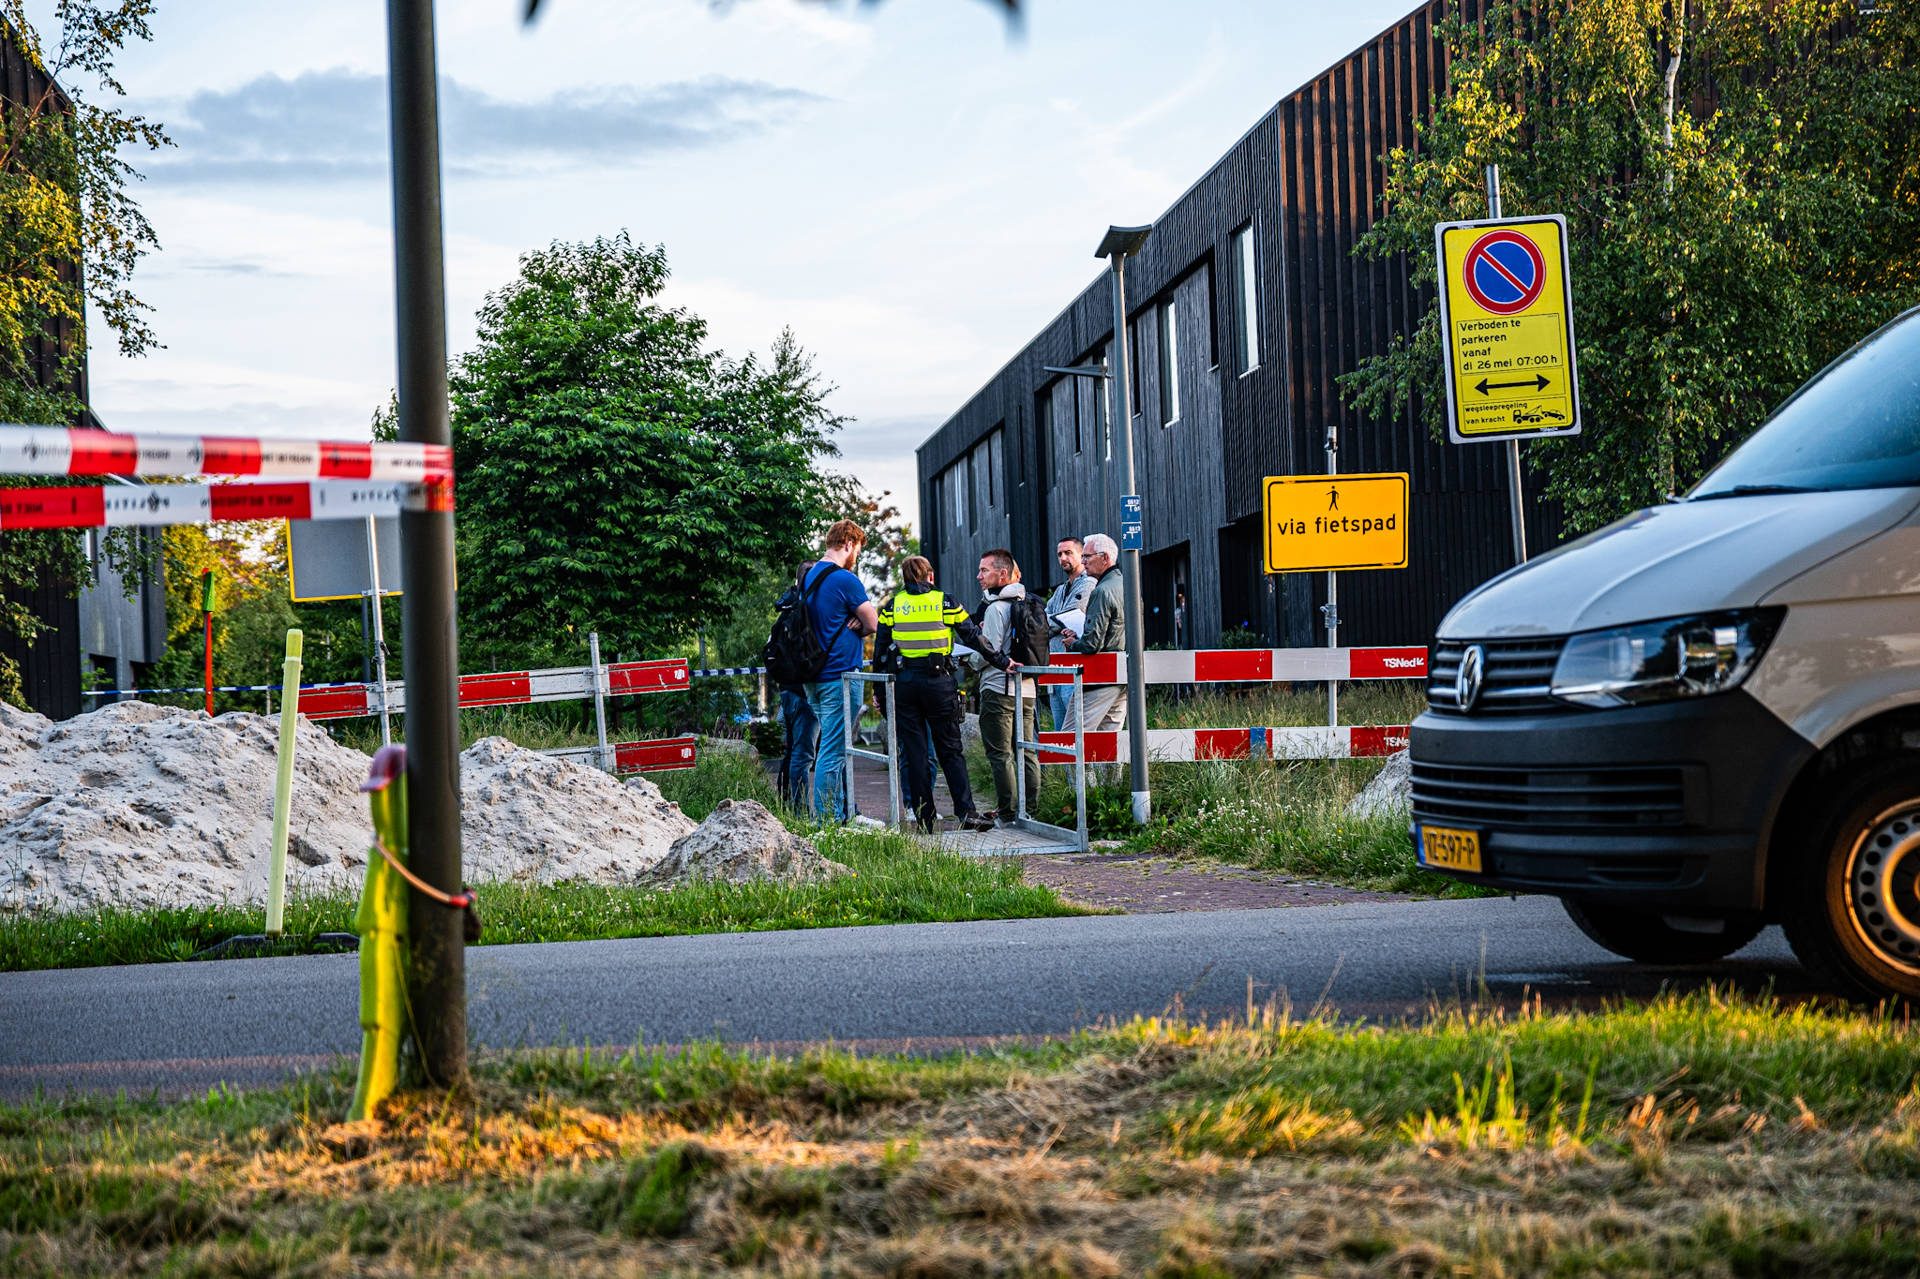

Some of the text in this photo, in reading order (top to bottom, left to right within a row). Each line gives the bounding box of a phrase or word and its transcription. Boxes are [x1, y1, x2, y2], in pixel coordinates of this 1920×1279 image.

[1460, 319, 1521, 331] Verboden te
[1461, 334, 1507, 346] parkeren
[1462, 347, 1491, 358] vanaf
[1463, 354, 1557, 371] di 26 mei 07:00 h
[1464, 402, 1528, 413] wegsleepregeling
[1481, 416, 1505, 424] kracht
[1277, 513, 1396, 535] via fietspad
[1383, 657, 1416, 669] TSNed
